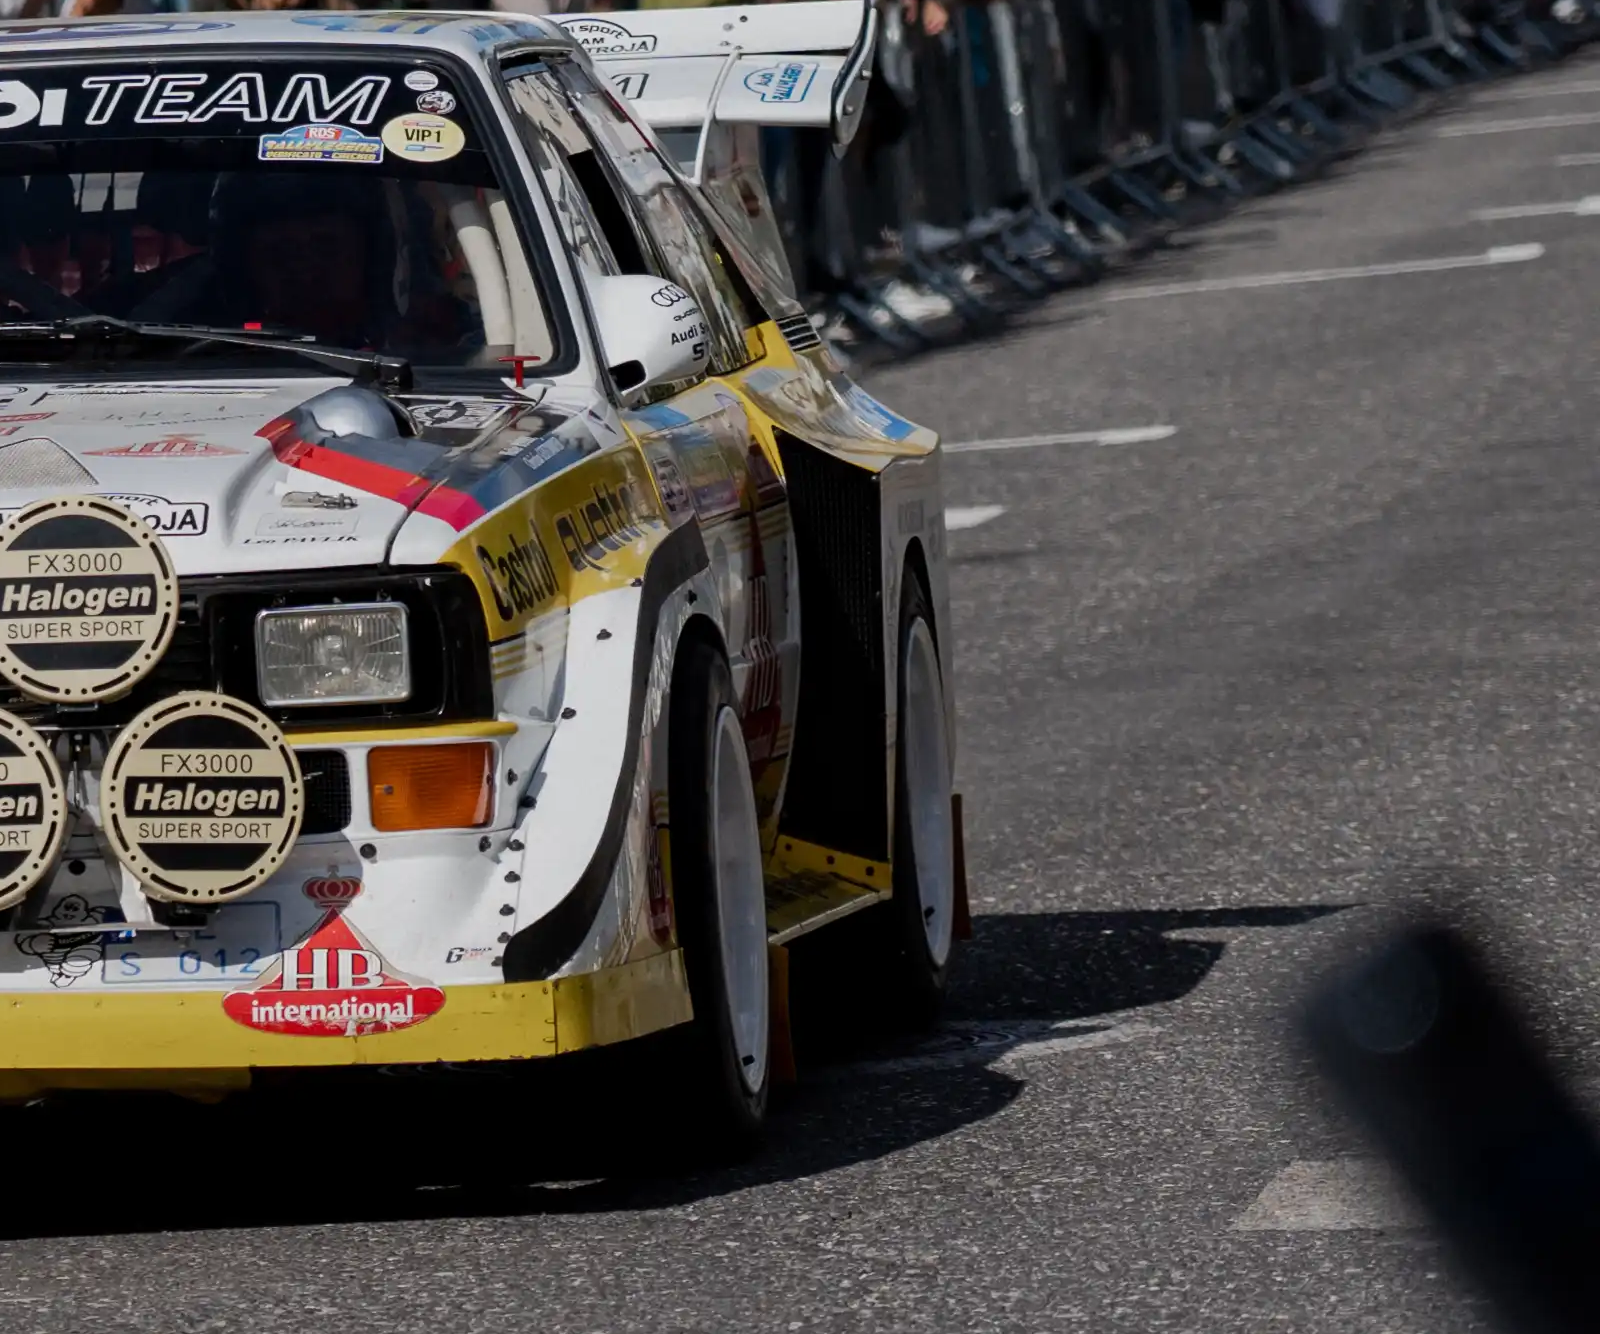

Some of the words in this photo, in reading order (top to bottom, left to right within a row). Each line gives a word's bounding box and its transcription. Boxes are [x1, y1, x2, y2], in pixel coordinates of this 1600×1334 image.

[579, 24, 625, 40] sport
[82, 72, 392, 126] TEAM
[308, 126, 337, 139] RDS
[404, 128, 432, 142] VIP
[435, 129, 442, 143] 1
[671, 324, 699, 346] Audi
[27, 552, 123, 574] FX3000
[476, 518, 560, 622] Castrol
[1, 582, 152, 616] Halogen
[7, 622, 73, 640] SUPER
[79, 620, 145, 637] SPORT
[161, 753, 253, 774] FX3000
[133, 781, 280, 817] Halogen
[138, 822, 202, 839] SUPER
[209, 822, 272, 839] SPORT
[119, 951, 142, 977] S
[178, 947, 261, 975] 012
[280, 947, 384, 991] HB
[250, 994, 415, 1025] international
